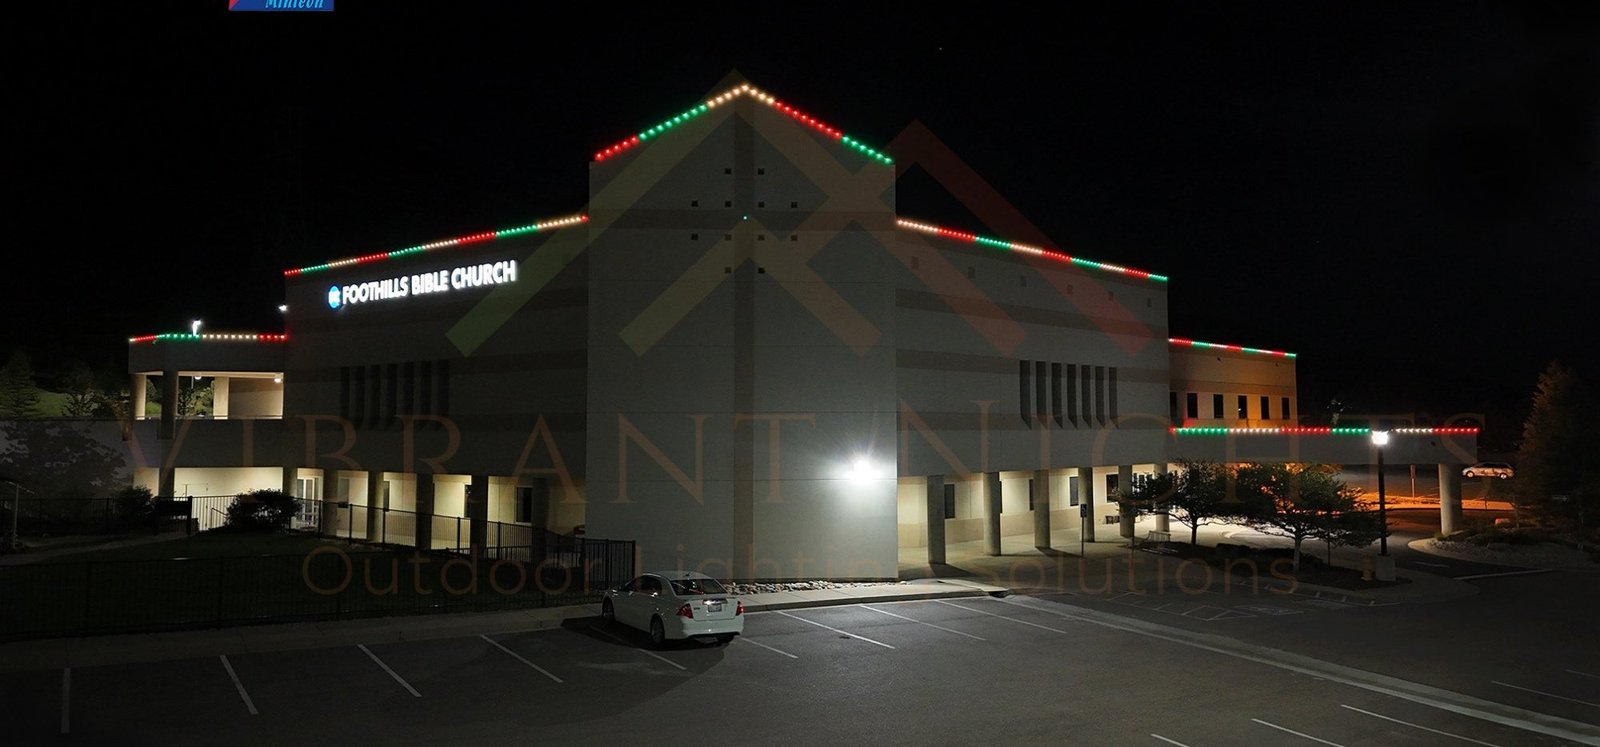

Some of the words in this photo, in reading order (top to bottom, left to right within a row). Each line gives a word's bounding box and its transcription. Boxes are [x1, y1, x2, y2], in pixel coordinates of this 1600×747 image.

[342, 276, 409, 305] FOOTHILLS
[411, 270, 450, 295] BIBLE
[451, 260, 516, 289] CHURCH
